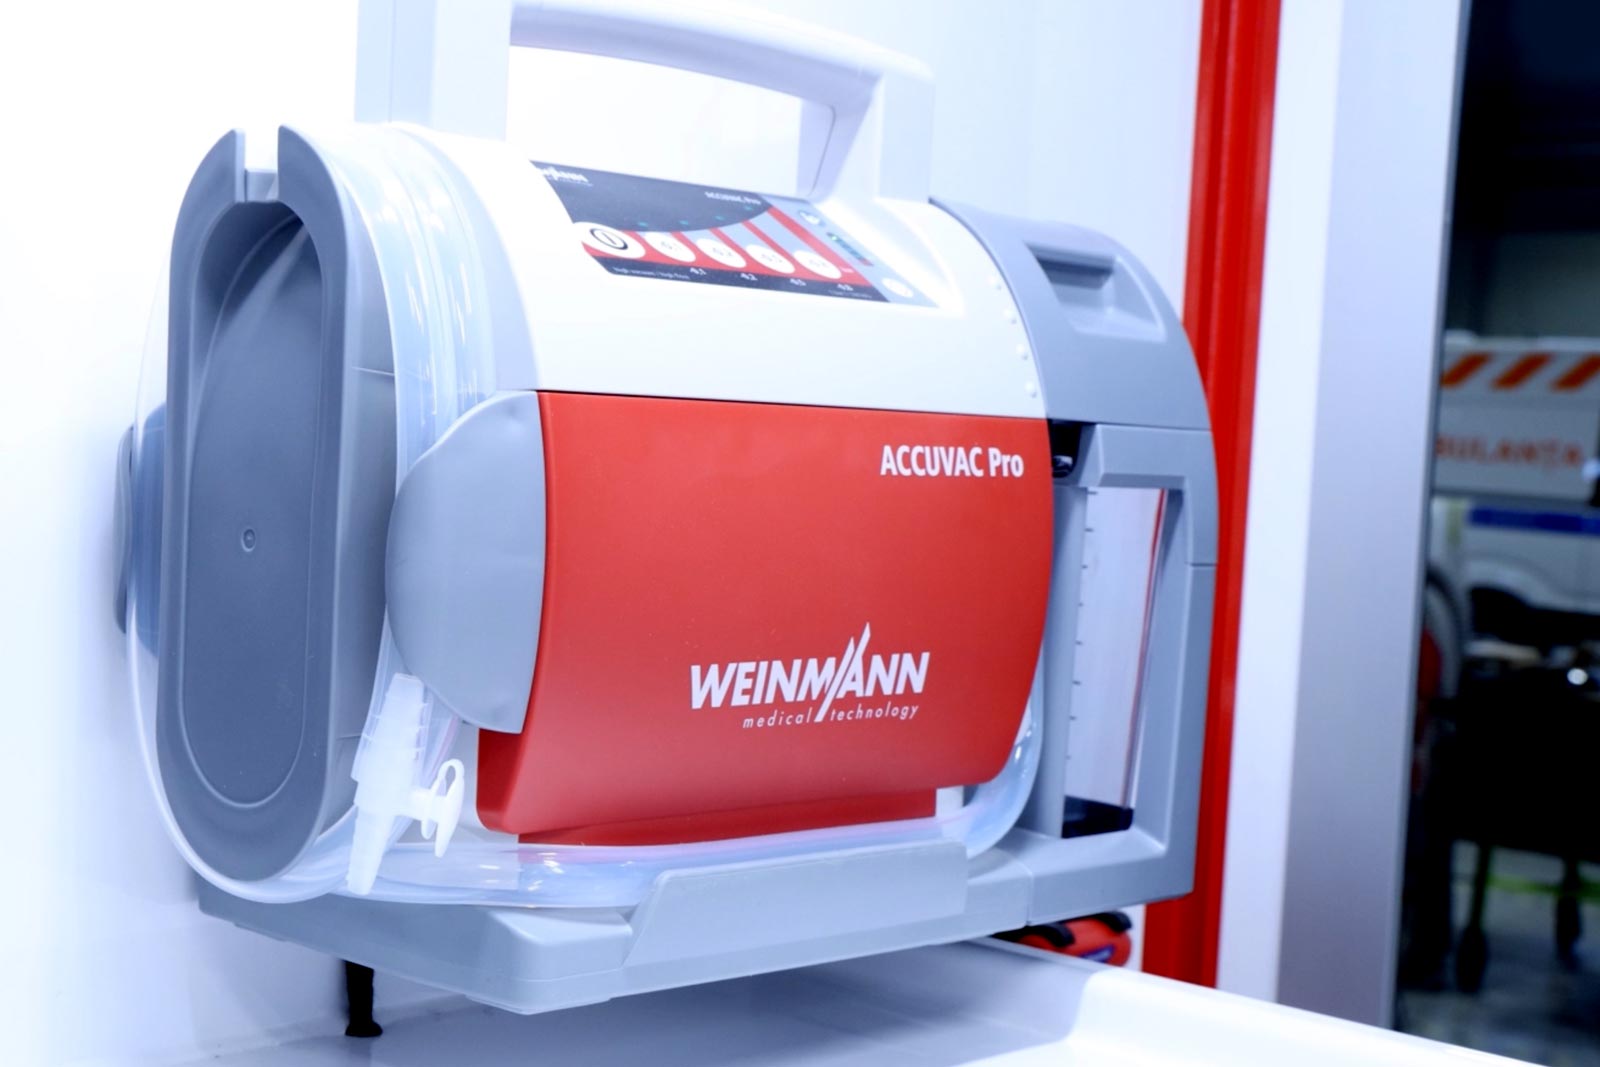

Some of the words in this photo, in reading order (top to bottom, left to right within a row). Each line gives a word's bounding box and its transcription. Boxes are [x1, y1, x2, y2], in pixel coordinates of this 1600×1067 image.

[880, 444, 984, 477] ACCUVAC
[988, 447, 1024, 478] Pro
[690, 621, 931, 722] WEINMANN
[742, 707, 812, 729] medical
[830, 701, 919, 722] technology
